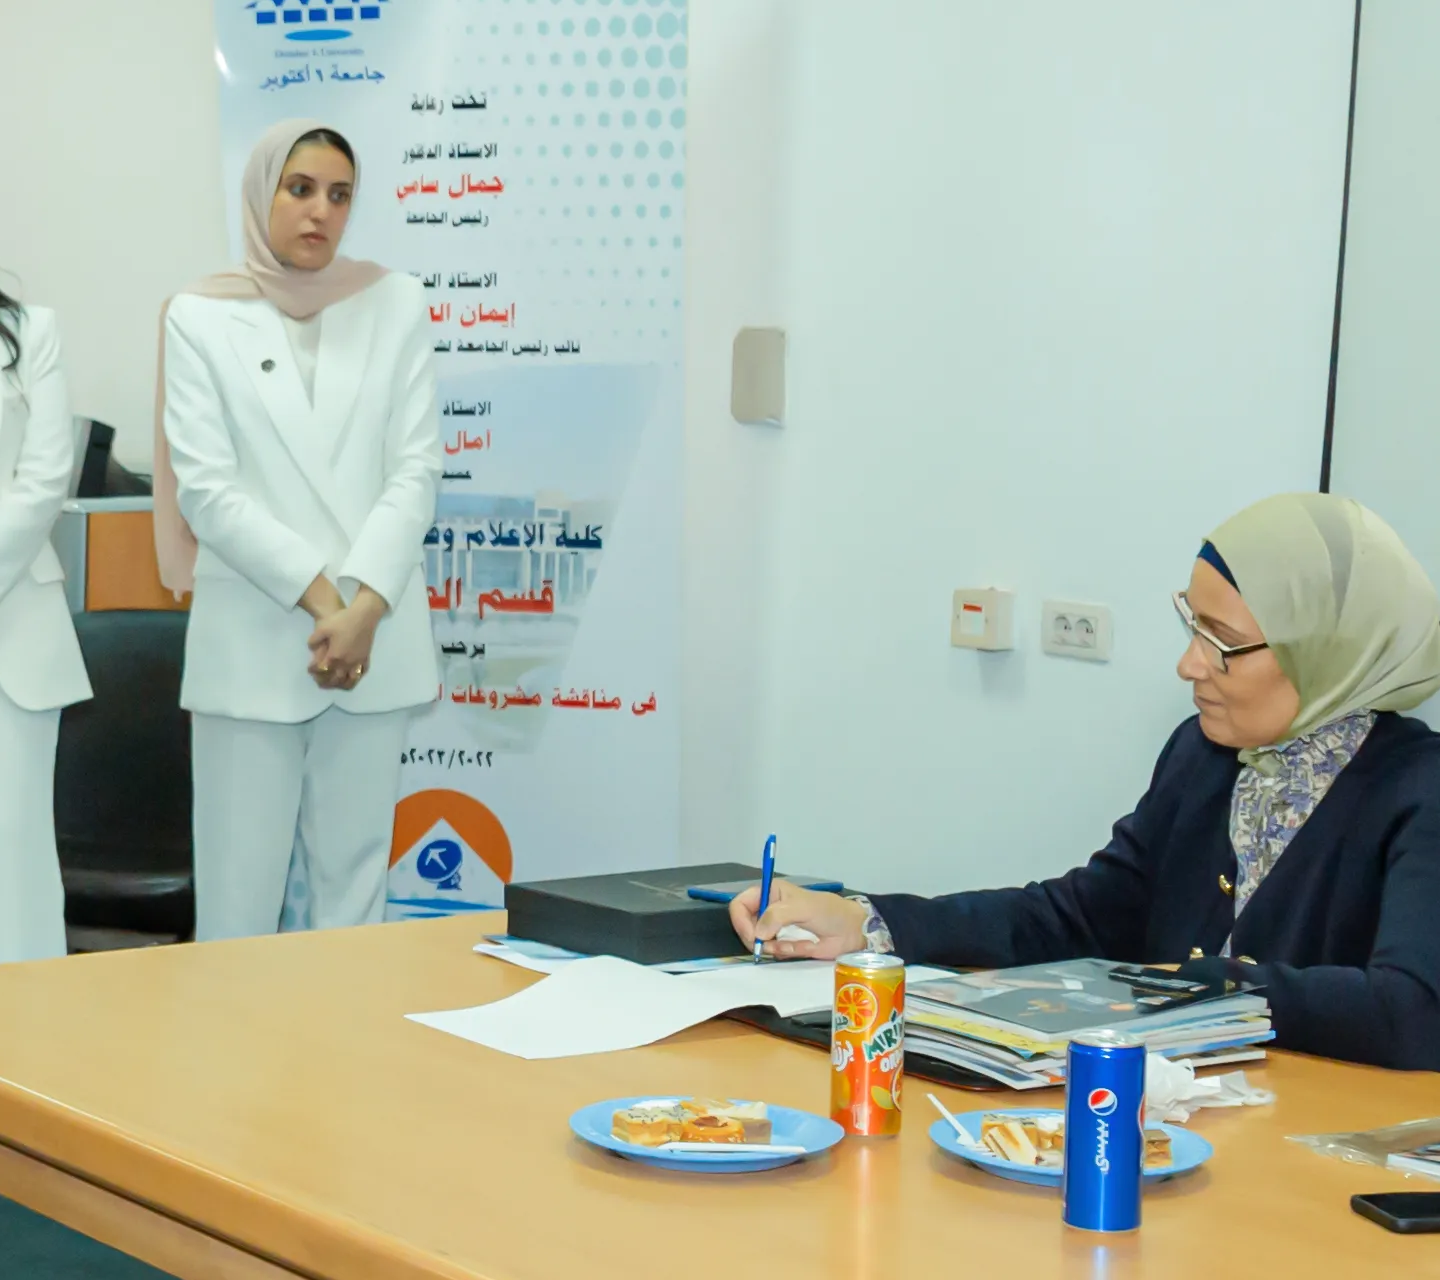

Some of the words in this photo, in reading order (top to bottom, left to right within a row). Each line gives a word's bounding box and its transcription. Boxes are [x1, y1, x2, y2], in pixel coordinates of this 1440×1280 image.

[258, 63, 311, 92] أكتوبر
[331, 63, 386, 85] جامعة
[411, 93, 445, 116] رعاية
[451, 91, 488, 110] تحت
[402, 142, 442, 164] الدكتور
[448, 173, 504, 200] جمال
[406, 210, 448, 227] الجامعة
[451, 208, 490, 227] رئيس
[460, 302, 515, 328] إيمان
[457, 339, 509, 356] الجامعة
[512, 339, 549, 357] رئيس
[555, 523, 604, 556] كلية
[478, 579, 555, 620] قسم
[441, 640, 486, 659] يرحب
[450, 683, 543, 711] مشروعات
[551, 687, 622, 711] مناقشة
